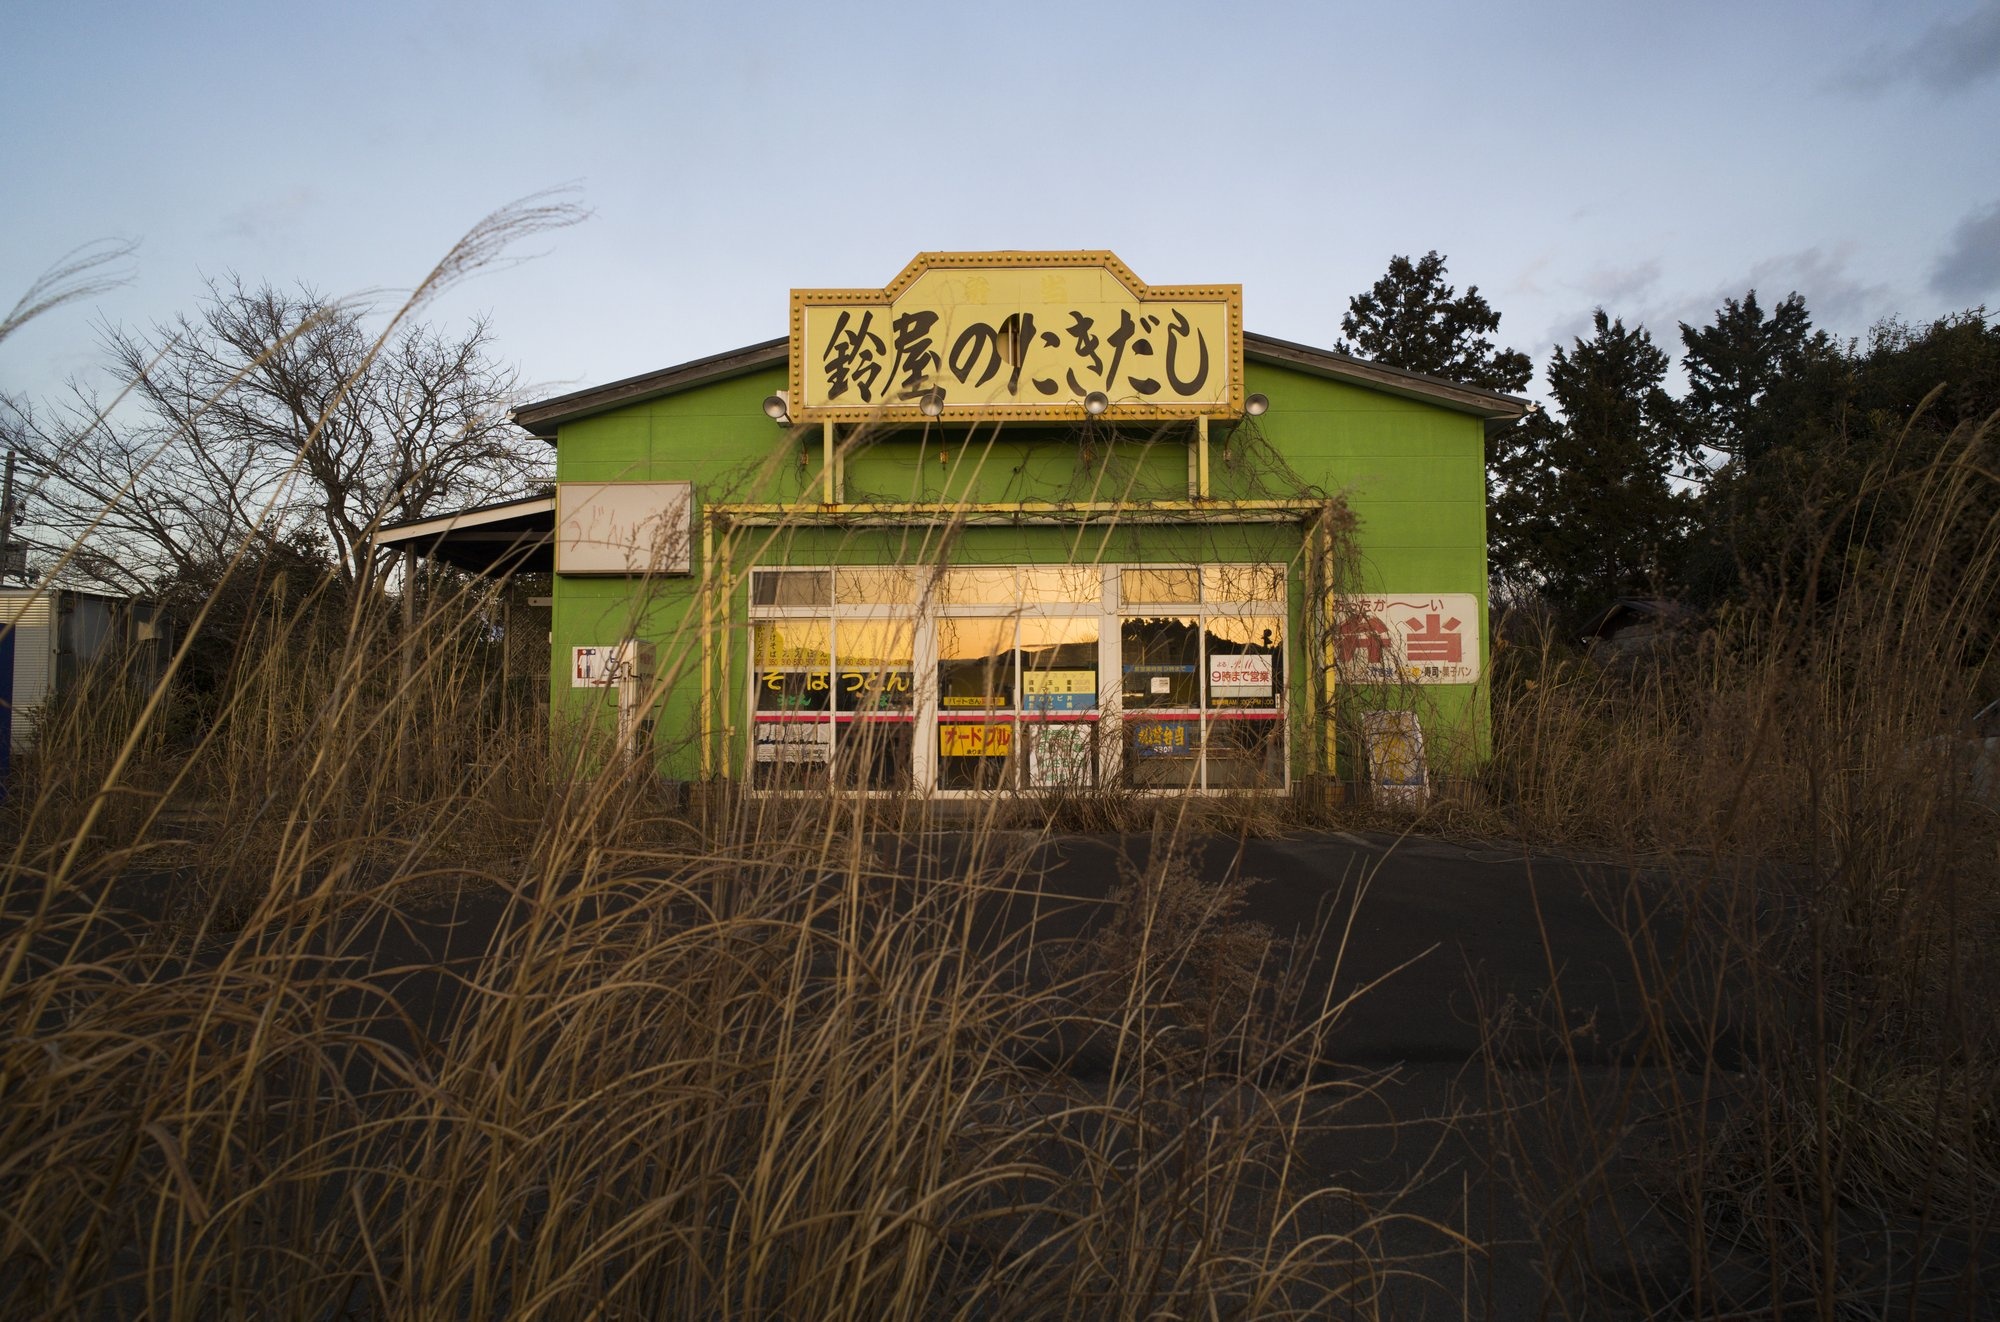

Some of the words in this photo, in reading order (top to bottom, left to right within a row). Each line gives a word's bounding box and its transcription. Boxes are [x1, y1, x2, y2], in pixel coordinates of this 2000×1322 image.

[823, 308, 1210, 404] 鈴屋のたきだし
[1333, 614, 1462, 663] 弁当
[1211, 670, 1270, 682] 9時まで営業
[944, 726, 1011, 747] オードブル
